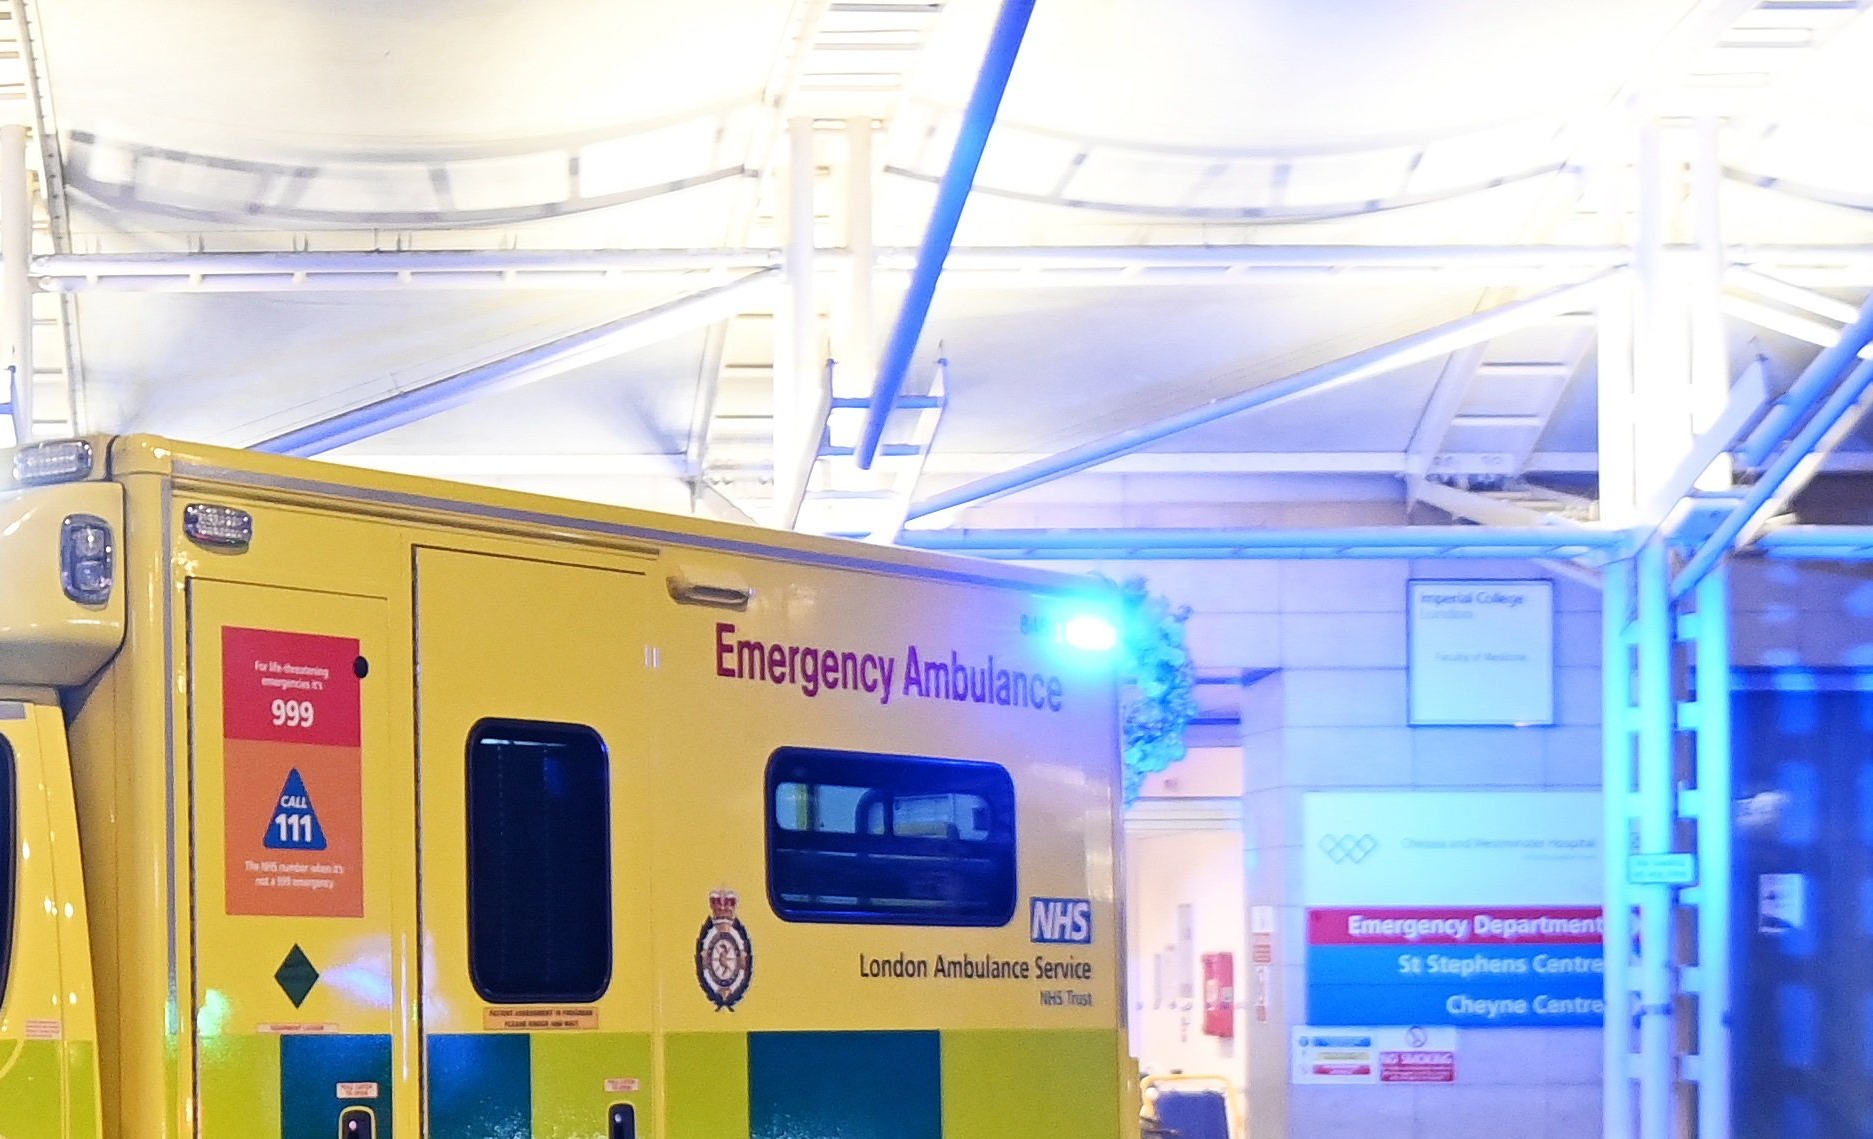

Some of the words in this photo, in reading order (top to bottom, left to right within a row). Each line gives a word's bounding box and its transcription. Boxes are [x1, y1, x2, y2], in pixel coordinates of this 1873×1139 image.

[254, 659, 268, 672] For
[715, 621, 895, 706] Emergency
[902, 644, 1063, 713] Ambulance
[271, 698, 315, 728] 999
[280, 795, 309, 809] CALL
[275, 813, 313, 843] 111
[1031, 899, 1089, 941] NHS
[1347, 914, 1471, 939] Emergency
[1473, 914, 1606, 938] Department
[859, 951, 928, 979] London
[933, 953, 1030, 980] Ambulance
[1034, 954, 1092, 980] Service
[1398, 953, 1421, 974] St
[1426, 953, 1527, 977] Stephens
[1531, 953, 1605, 974] Centre
[1039, 989, 1064, 1007] NHS
[1066, 989, 1093, 1008] Trust
[1444, 993, 1527, 1018] Cheyne
[1532, 994, 1606, 1015] Centre
